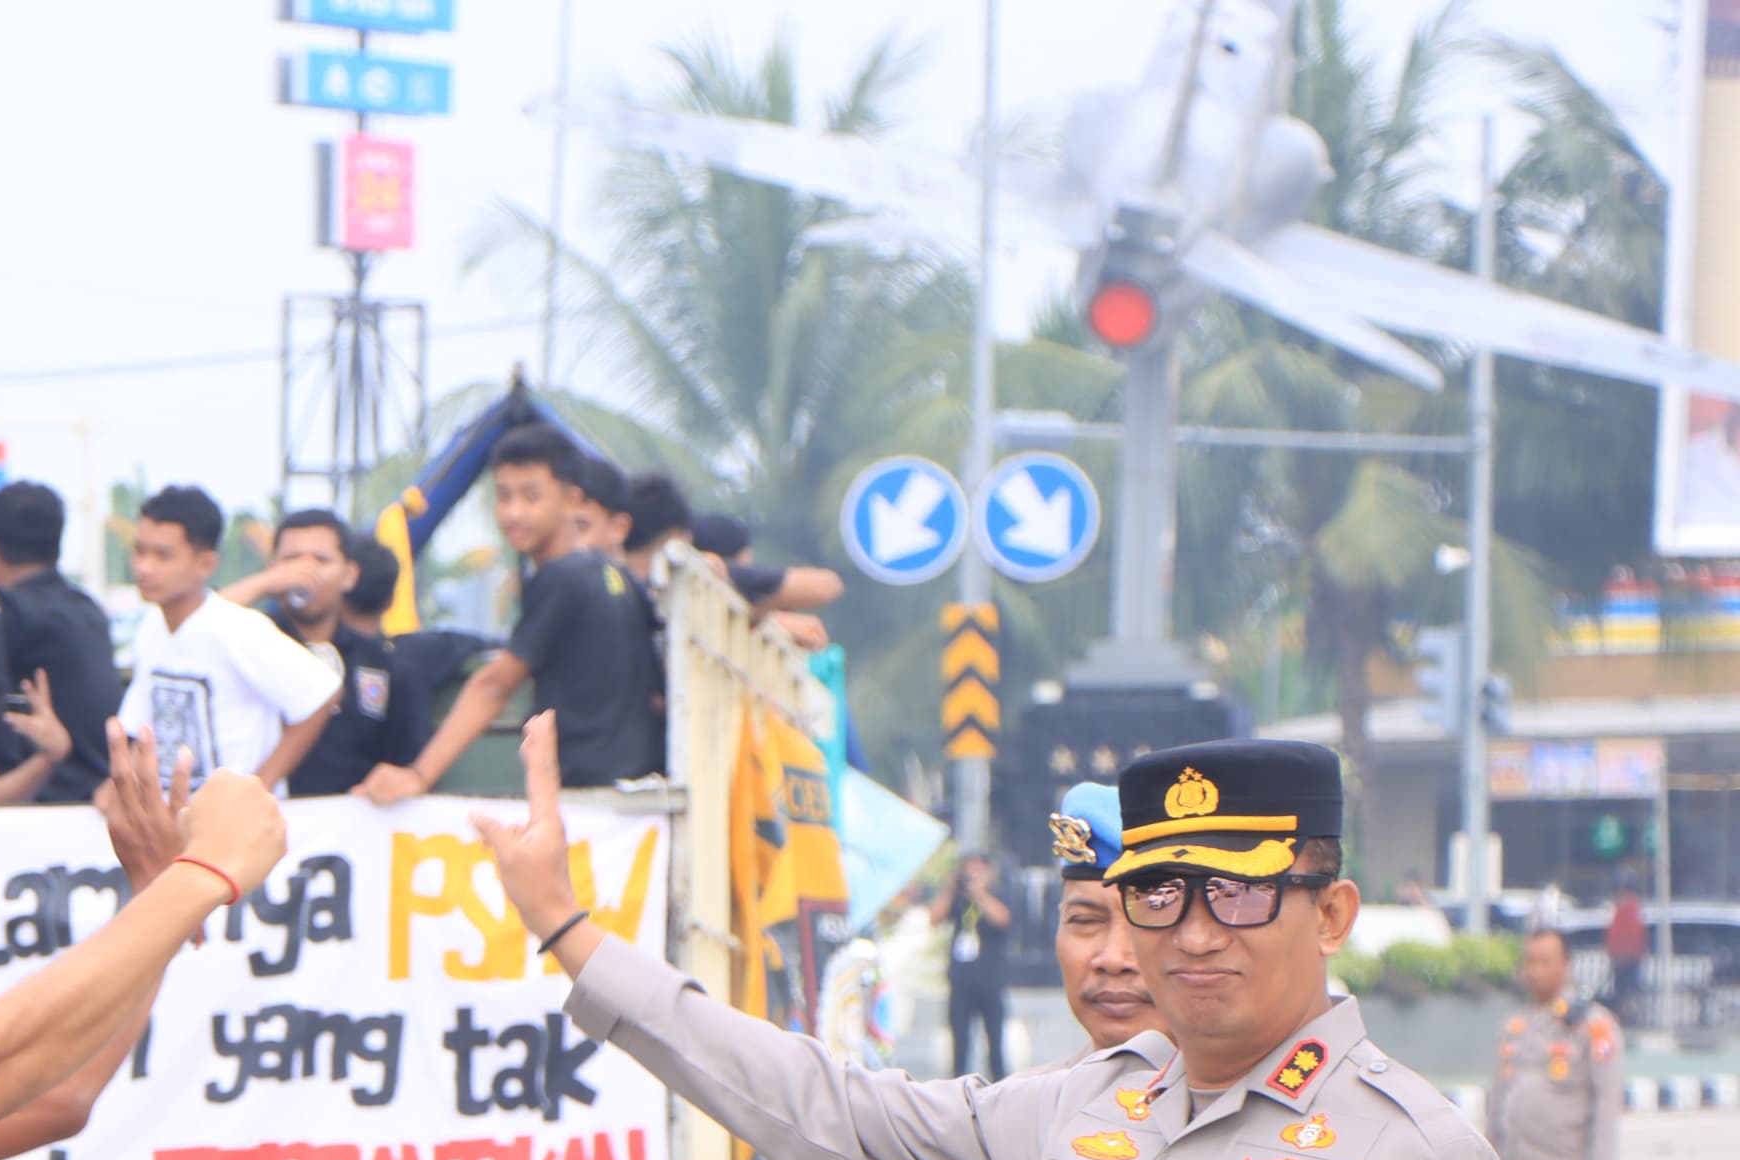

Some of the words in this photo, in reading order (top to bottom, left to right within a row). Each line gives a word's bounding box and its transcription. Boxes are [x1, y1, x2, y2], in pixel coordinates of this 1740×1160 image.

[388, 826, 660, 982] PSW
[204, 1004, 405, 1107] yang
[442, 1007, 600, 1122] tak
